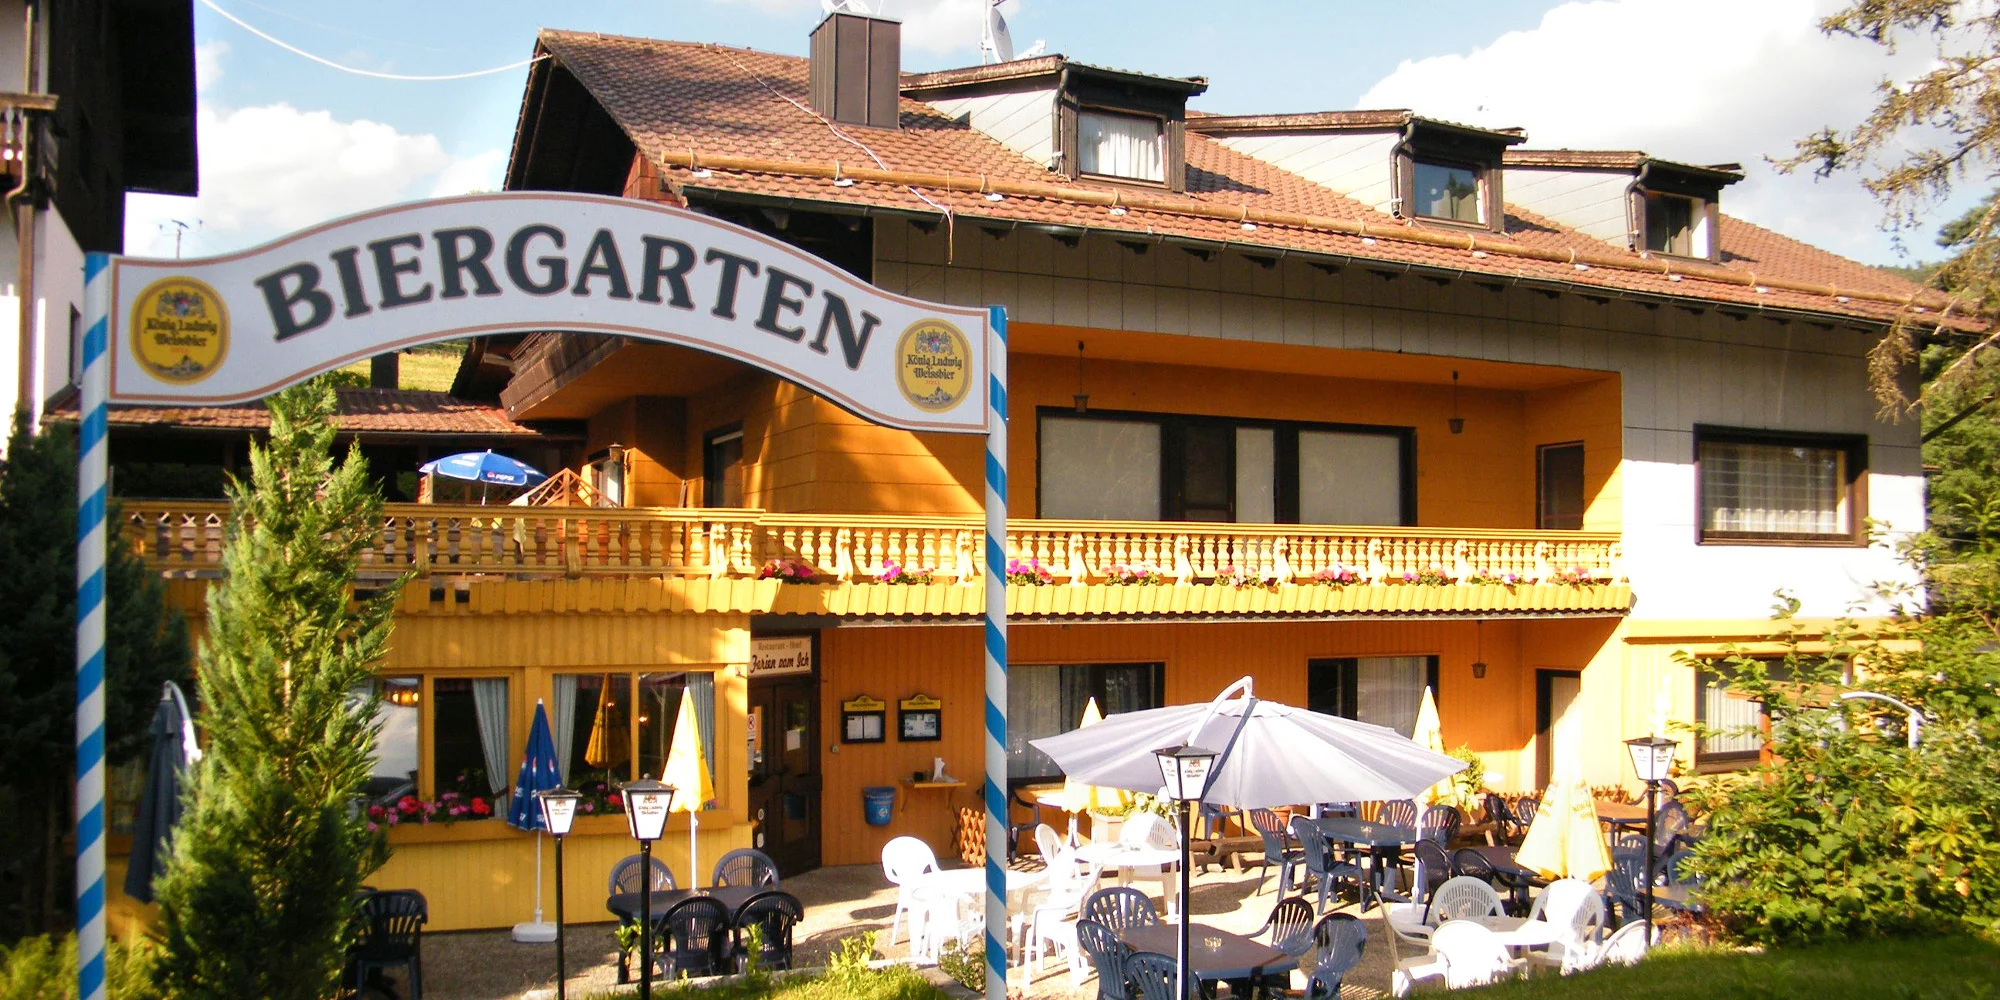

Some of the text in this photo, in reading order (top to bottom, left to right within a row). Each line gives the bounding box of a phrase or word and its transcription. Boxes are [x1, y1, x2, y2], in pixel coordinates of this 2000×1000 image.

[254, 223, 881, 371] BIERGARTEN
[906, 353, 963, 370] König Ludwig
[913, 366, 955, 380] Weissbier
